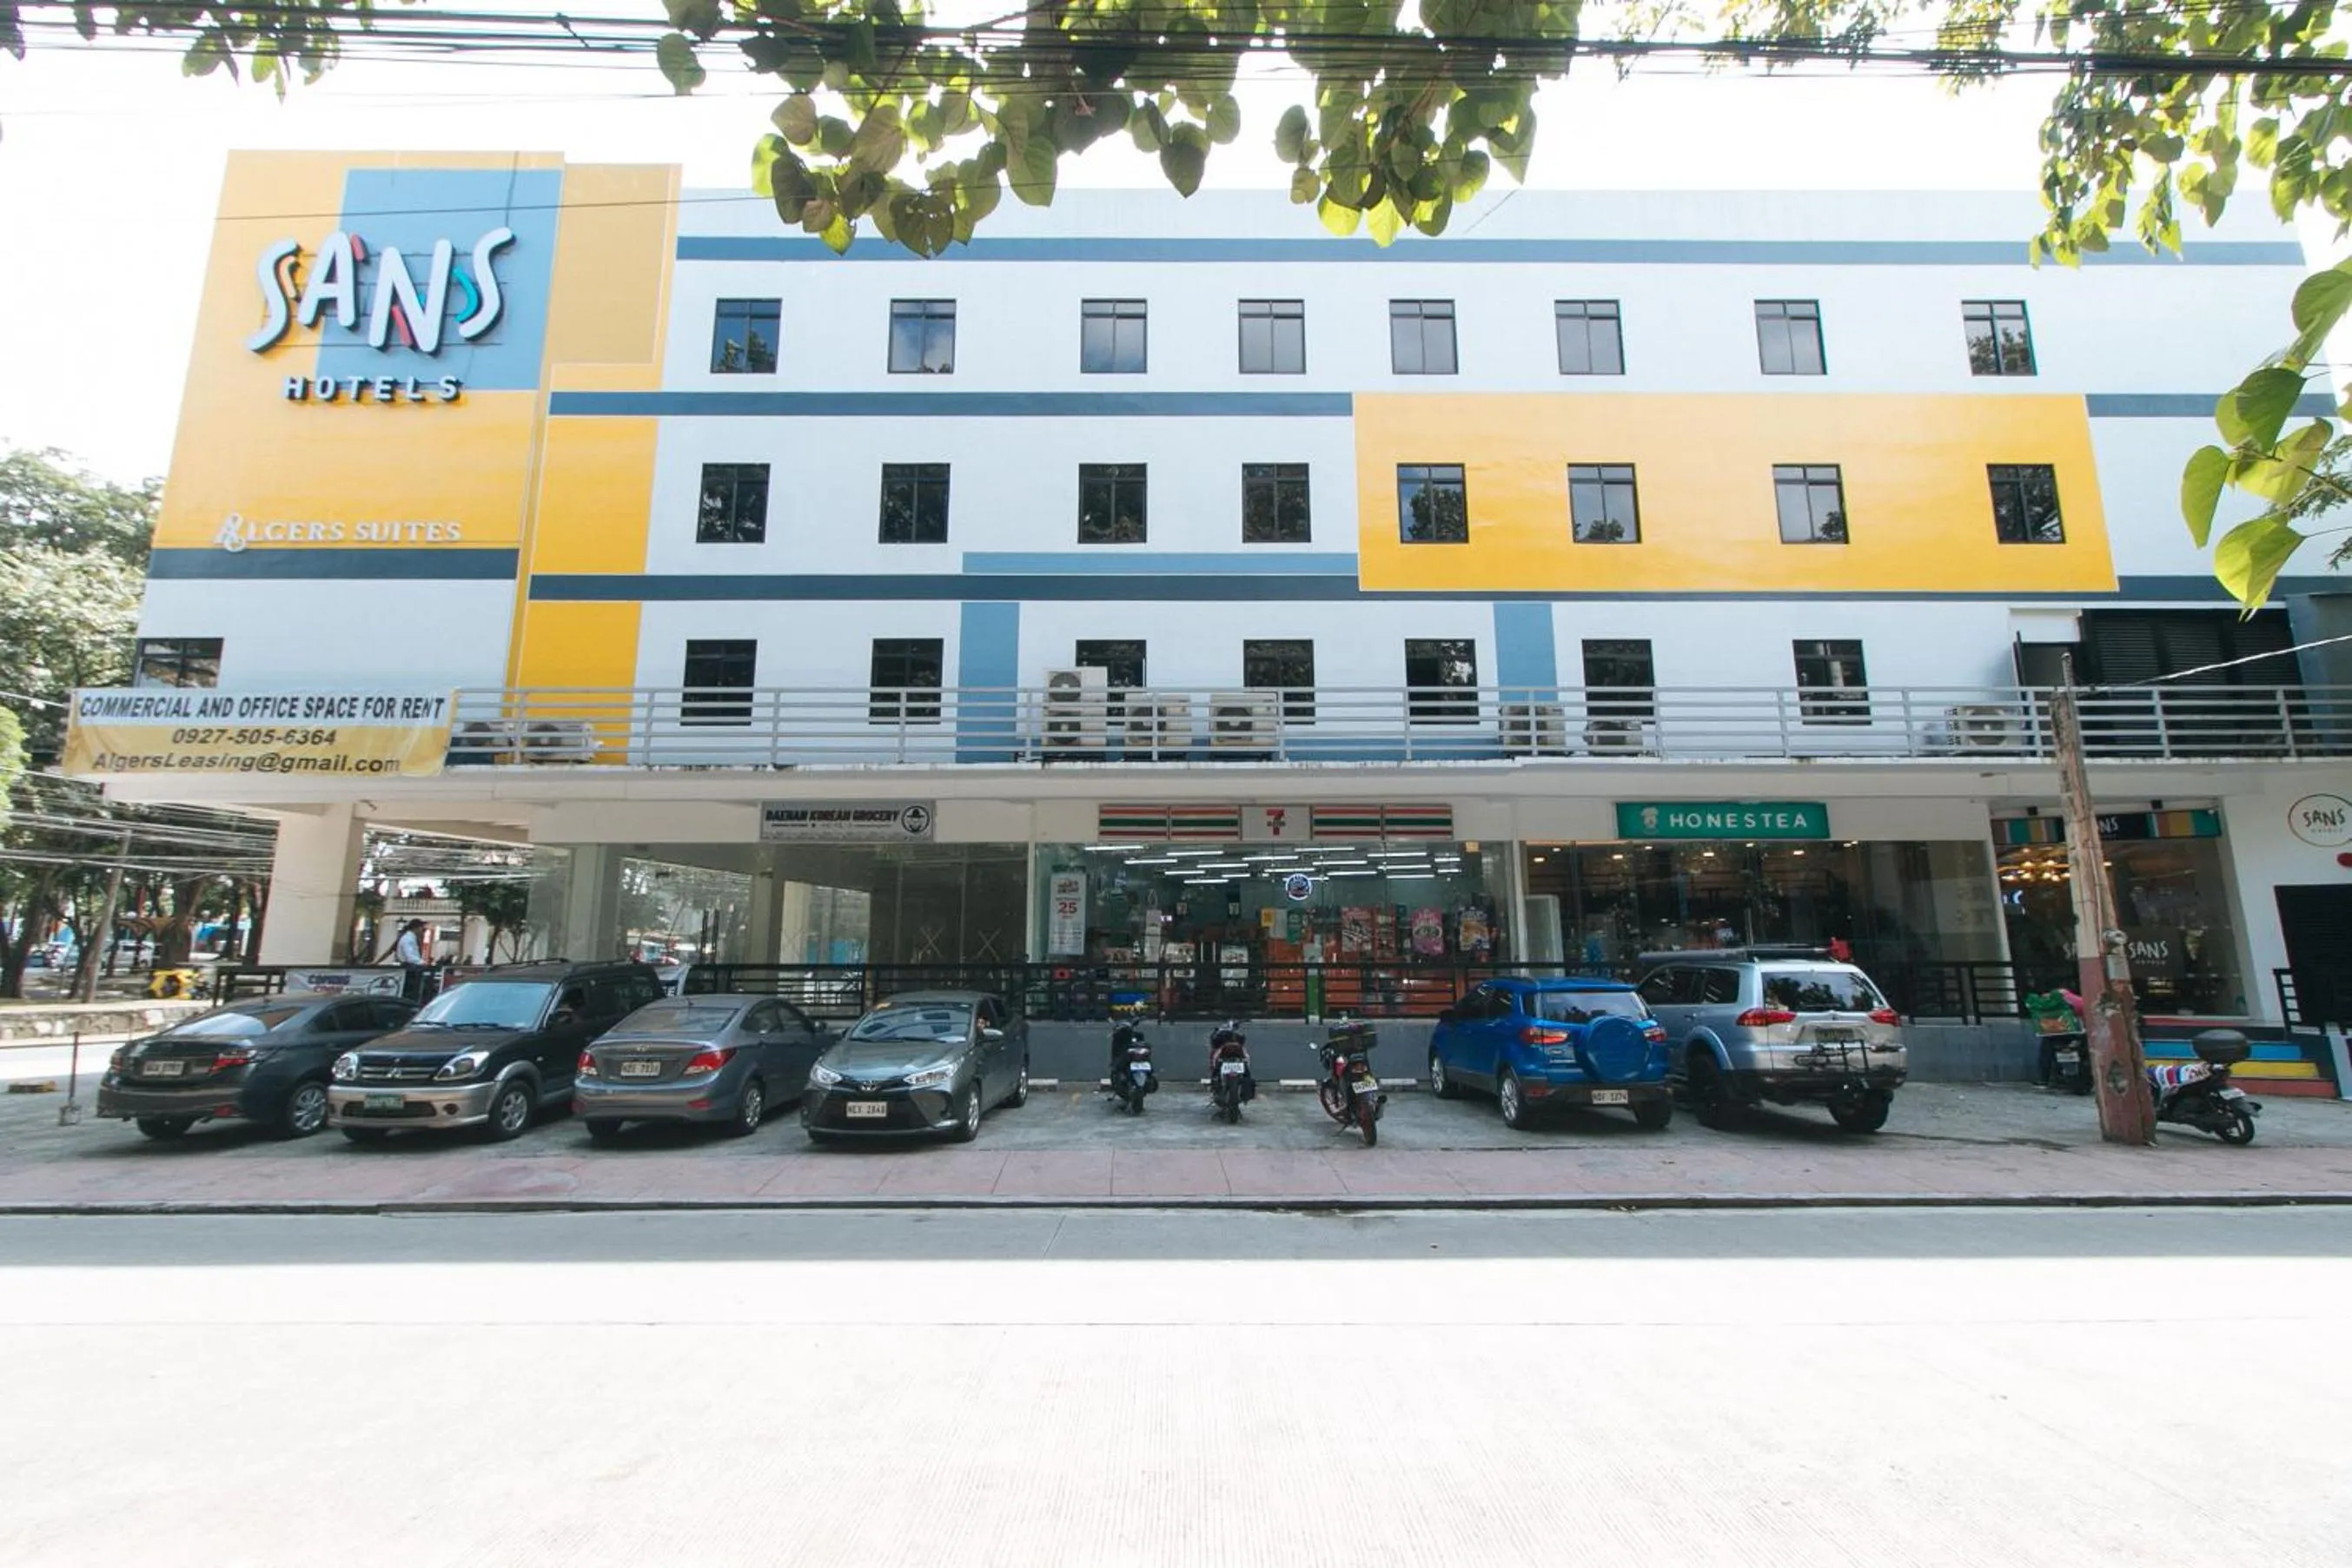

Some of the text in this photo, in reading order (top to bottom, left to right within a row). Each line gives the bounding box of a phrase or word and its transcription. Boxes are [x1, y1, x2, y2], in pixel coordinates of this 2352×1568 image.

[246, 226, 514, 353] SANS
[283, 375, 460, 400] HOTELS
[353, 521, 462, 542] SUITES
[79, 696, 446, 720] COMMERCIAL AND OFFICE SPACE FOR RENT
[171, 728, 337, 745] 0927-505-6364
[92, 751, 401, 773] AlgersLeasing@gmail.com
[1668, 813, 1808, 828] HONESTEA
[2098, 817, 2119, 833] NS
[2302, 808, 2346, 827] SANS
[1057, 902, 1078, 914] 25
[2128, 940, 2169, 959] SANS
